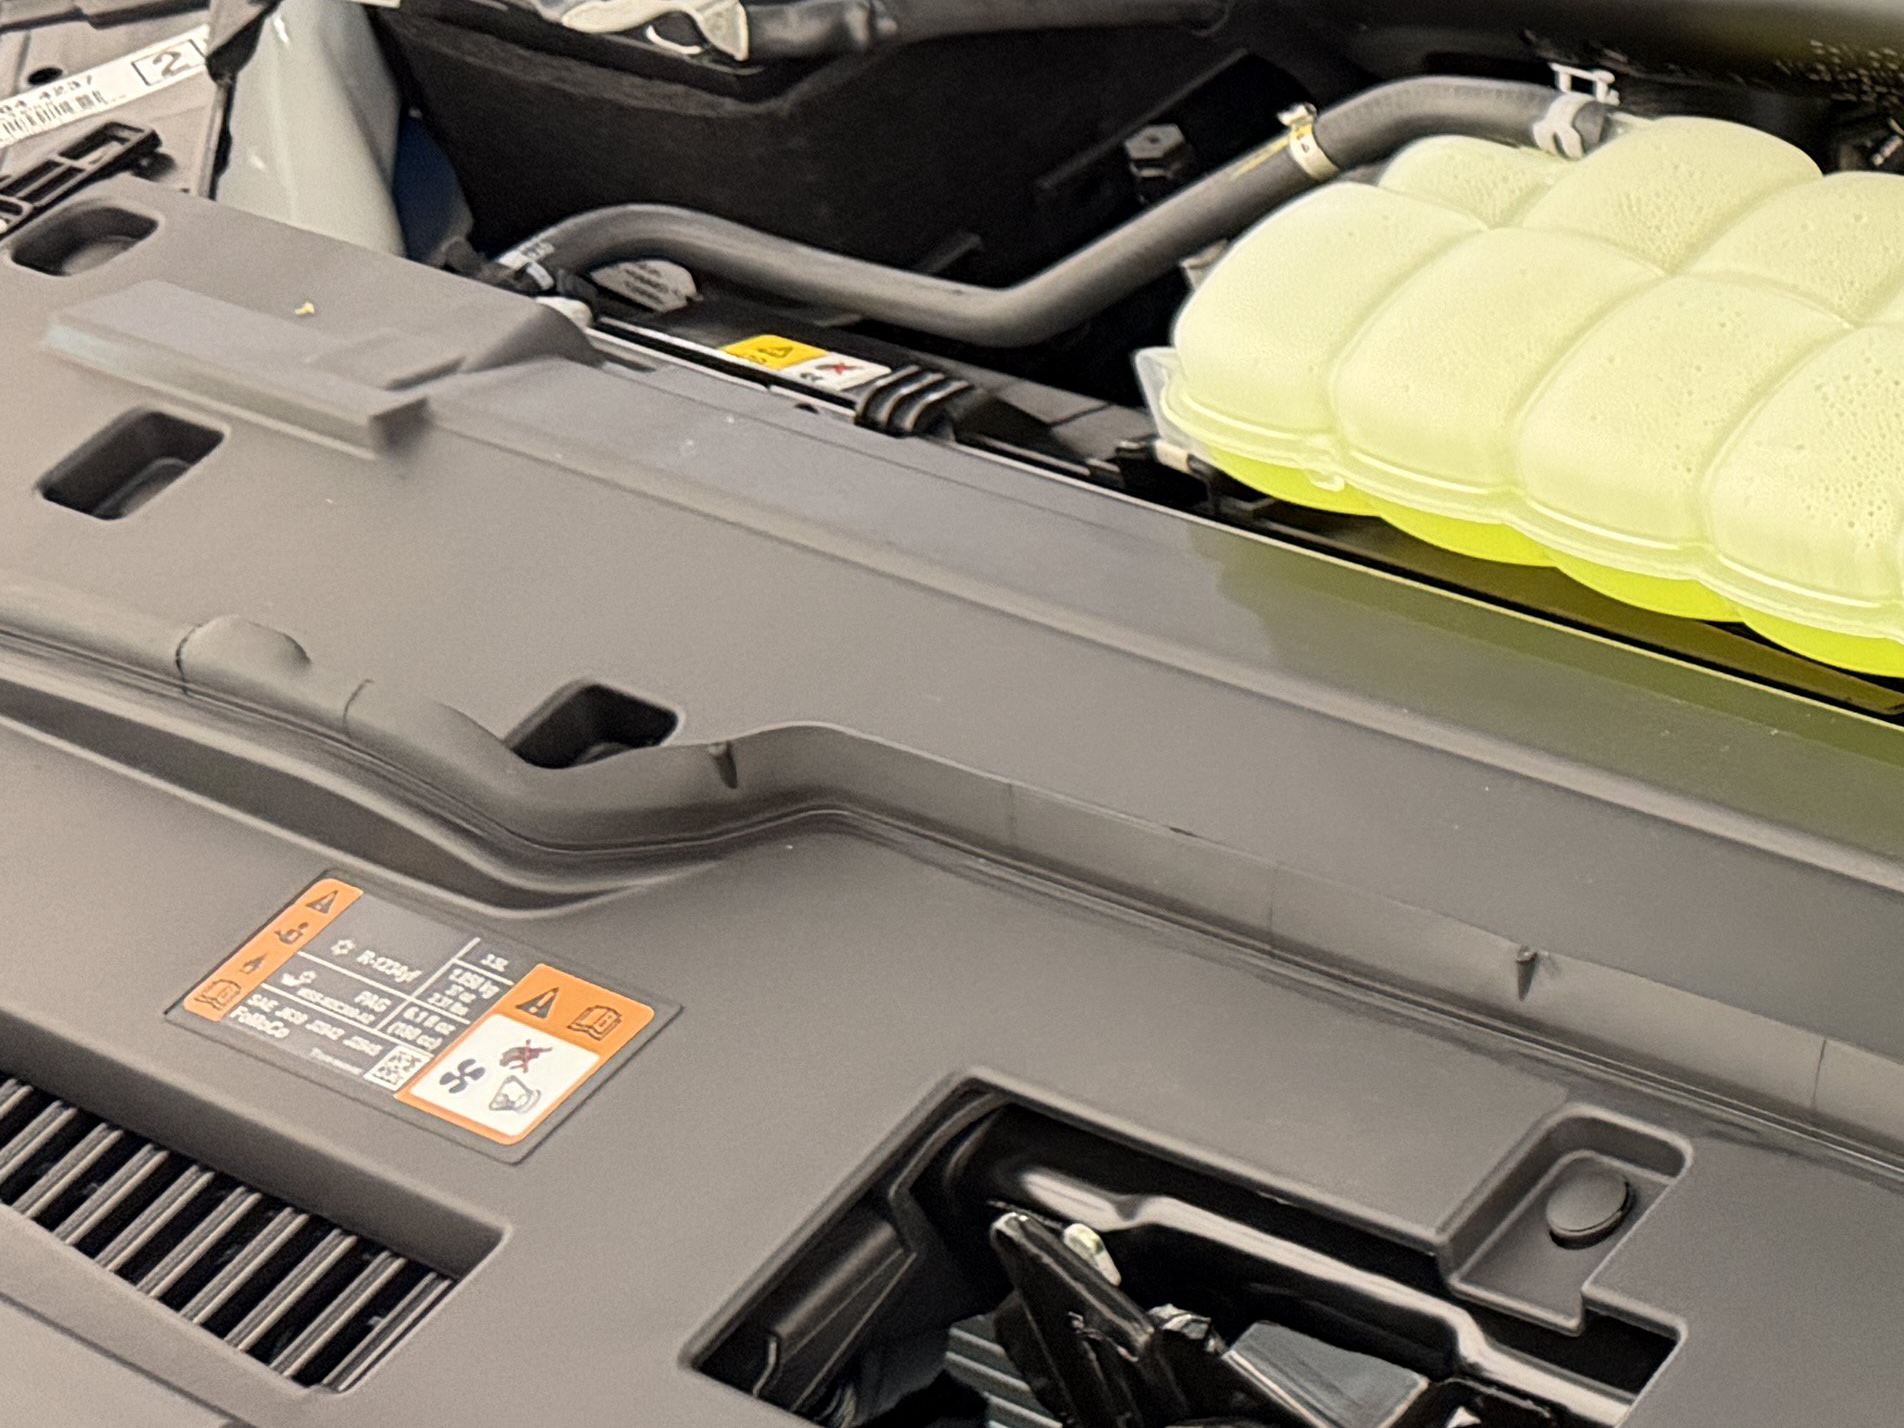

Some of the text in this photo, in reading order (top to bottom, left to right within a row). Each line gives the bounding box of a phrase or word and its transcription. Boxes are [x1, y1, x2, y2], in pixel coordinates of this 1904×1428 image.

[152, 50, 191, 78] 2
[246, 993, 280, 1013] SAE
[354, 990, 392, 1013] PAG
[229, 1005, 290, 1039] FoMoCo
